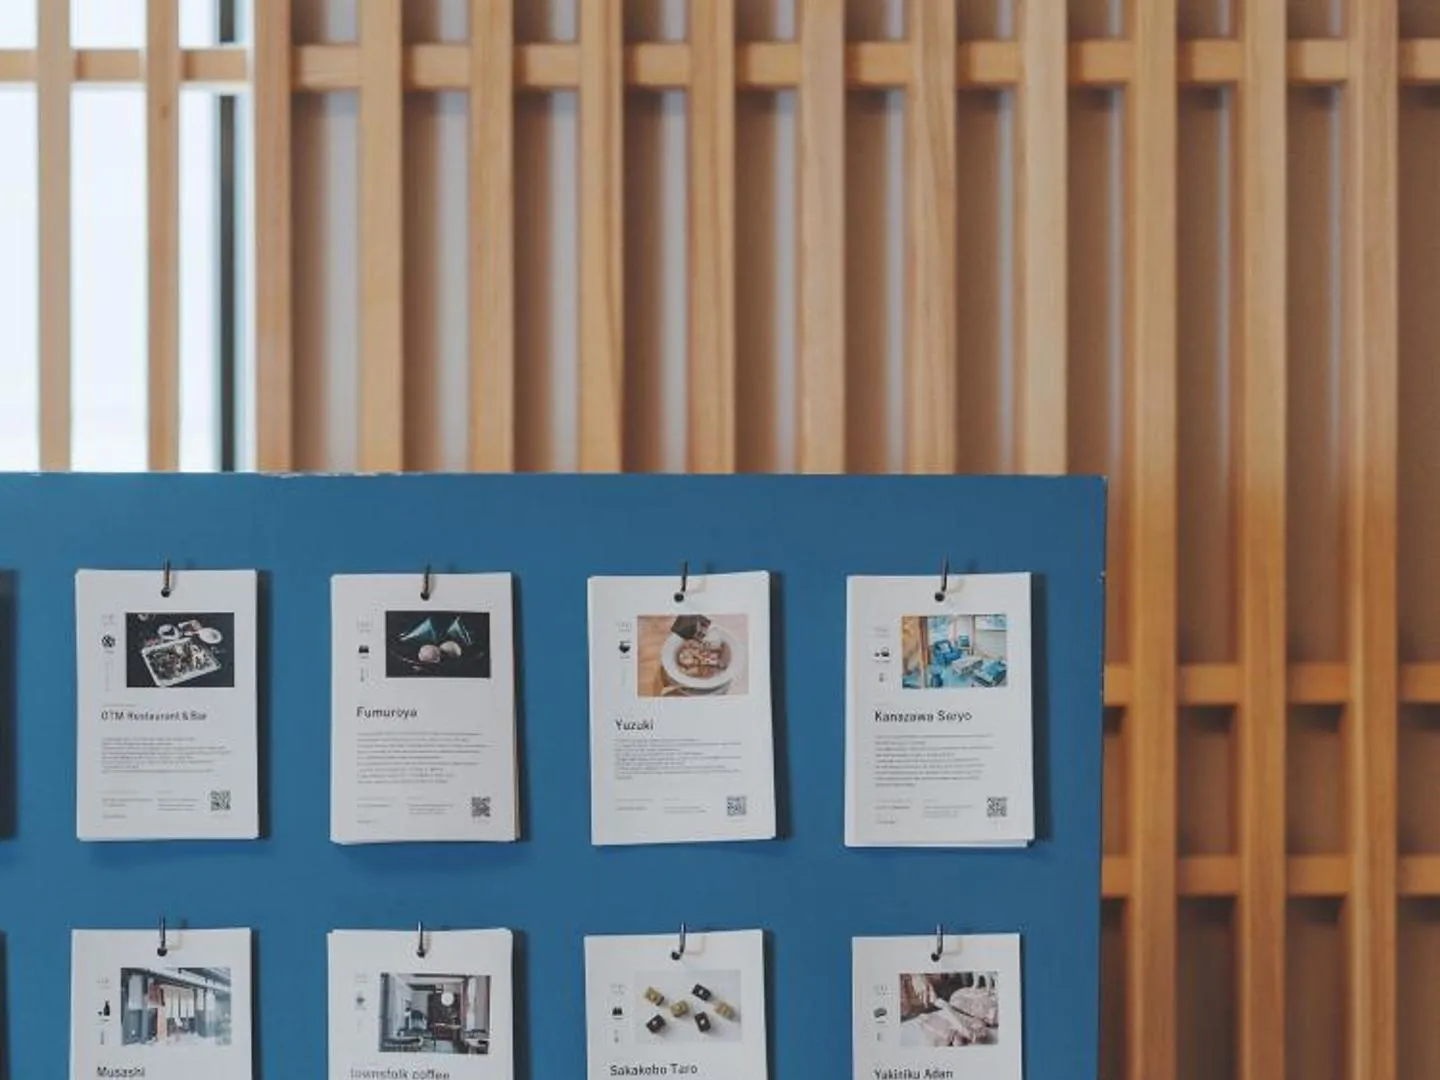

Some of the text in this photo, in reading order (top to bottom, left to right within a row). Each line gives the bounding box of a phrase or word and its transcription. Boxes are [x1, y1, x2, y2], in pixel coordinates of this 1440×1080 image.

[874, 710, 934, 722] Kanazawa
[615, 717, 654, 731] Yuzuki
[96, 1065, 146, 1078] Musashi
[411, 1068, 450, 1080] coffee
[670, 1063, 698, 1075] Taro
